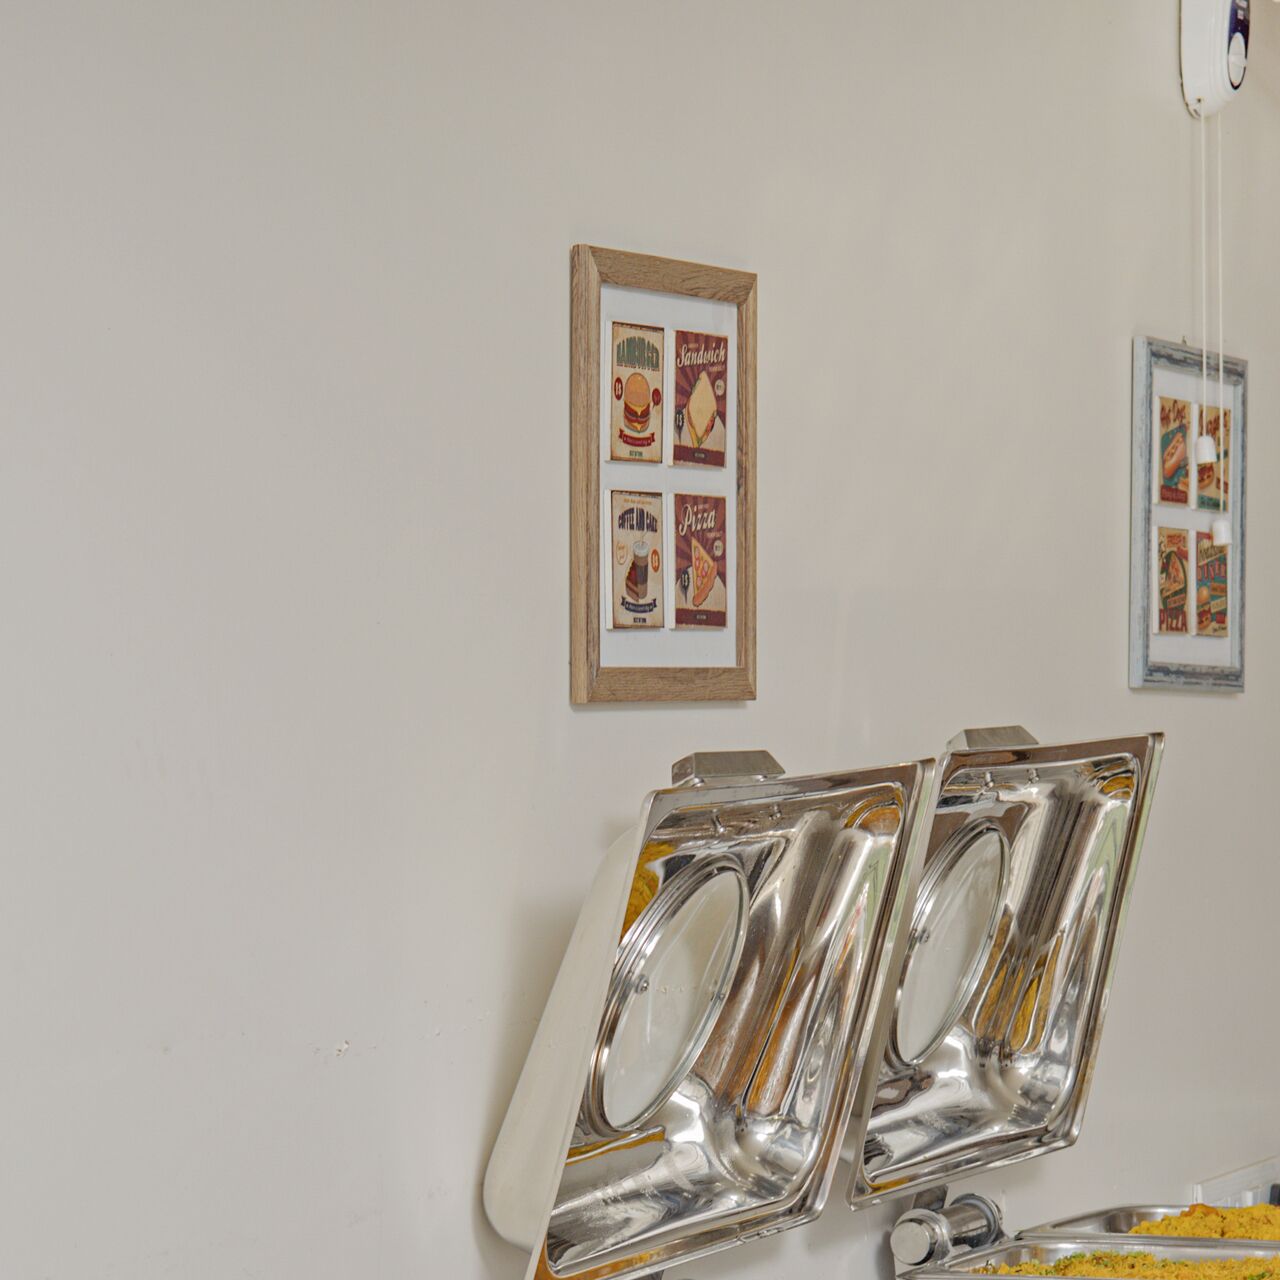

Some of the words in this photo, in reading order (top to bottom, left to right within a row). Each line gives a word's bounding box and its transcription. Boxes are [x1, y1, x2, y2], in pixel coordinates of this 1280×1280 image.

[677, 342, 726, 368] Sandwich
[618, 506, 635, 531] COFFEE
[635, 506, 645, 532] AND
[646, 510, 658, 533] CAKE
[679, 503, 716, 536] Pizza
[1159, 607, 1188, 632] PIZZA
